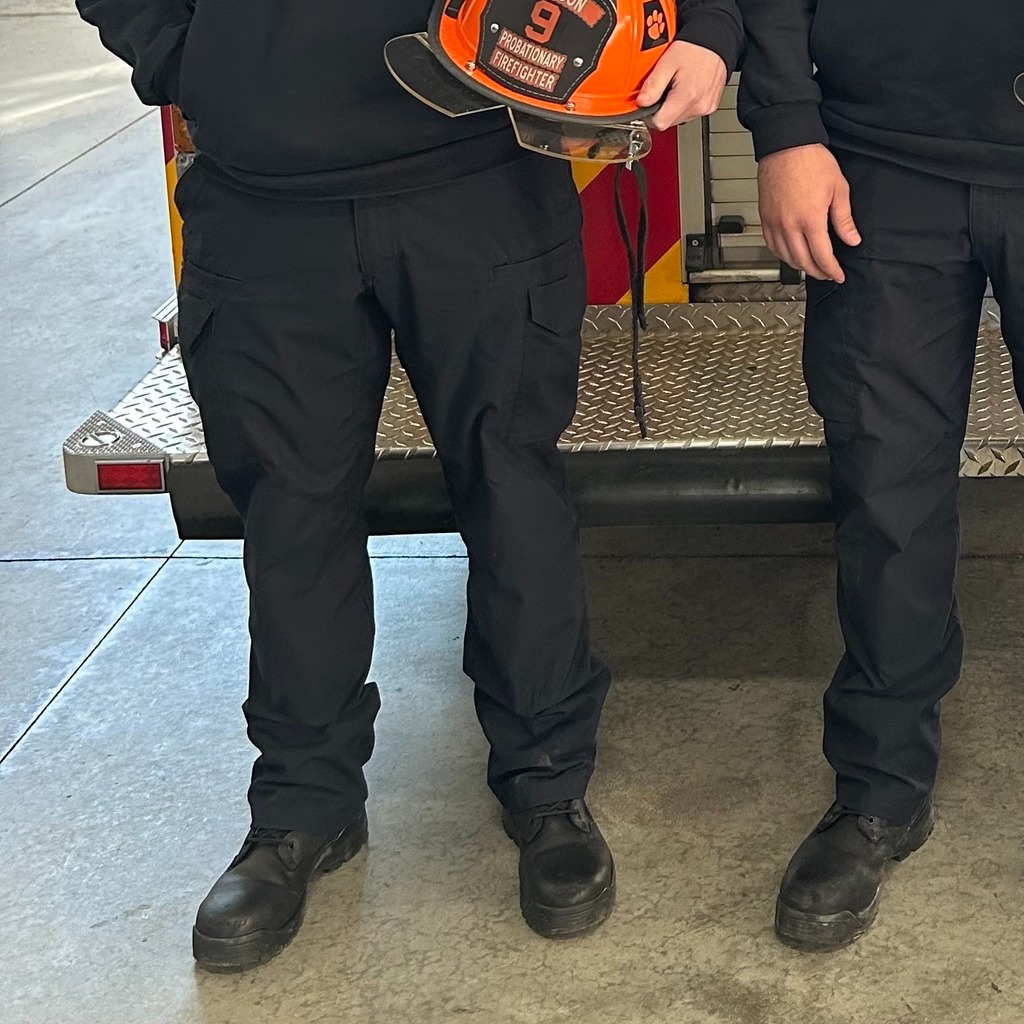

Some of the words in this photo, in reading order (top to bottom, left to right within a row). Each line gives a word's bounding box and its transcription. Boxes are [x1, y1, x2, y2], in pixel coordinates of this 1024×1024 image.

[524, 0, 561, 44] 9
[493, 51, 555, 89] FIREFIGHTER
[499, 31, 565, 70] PROBATIONARY
